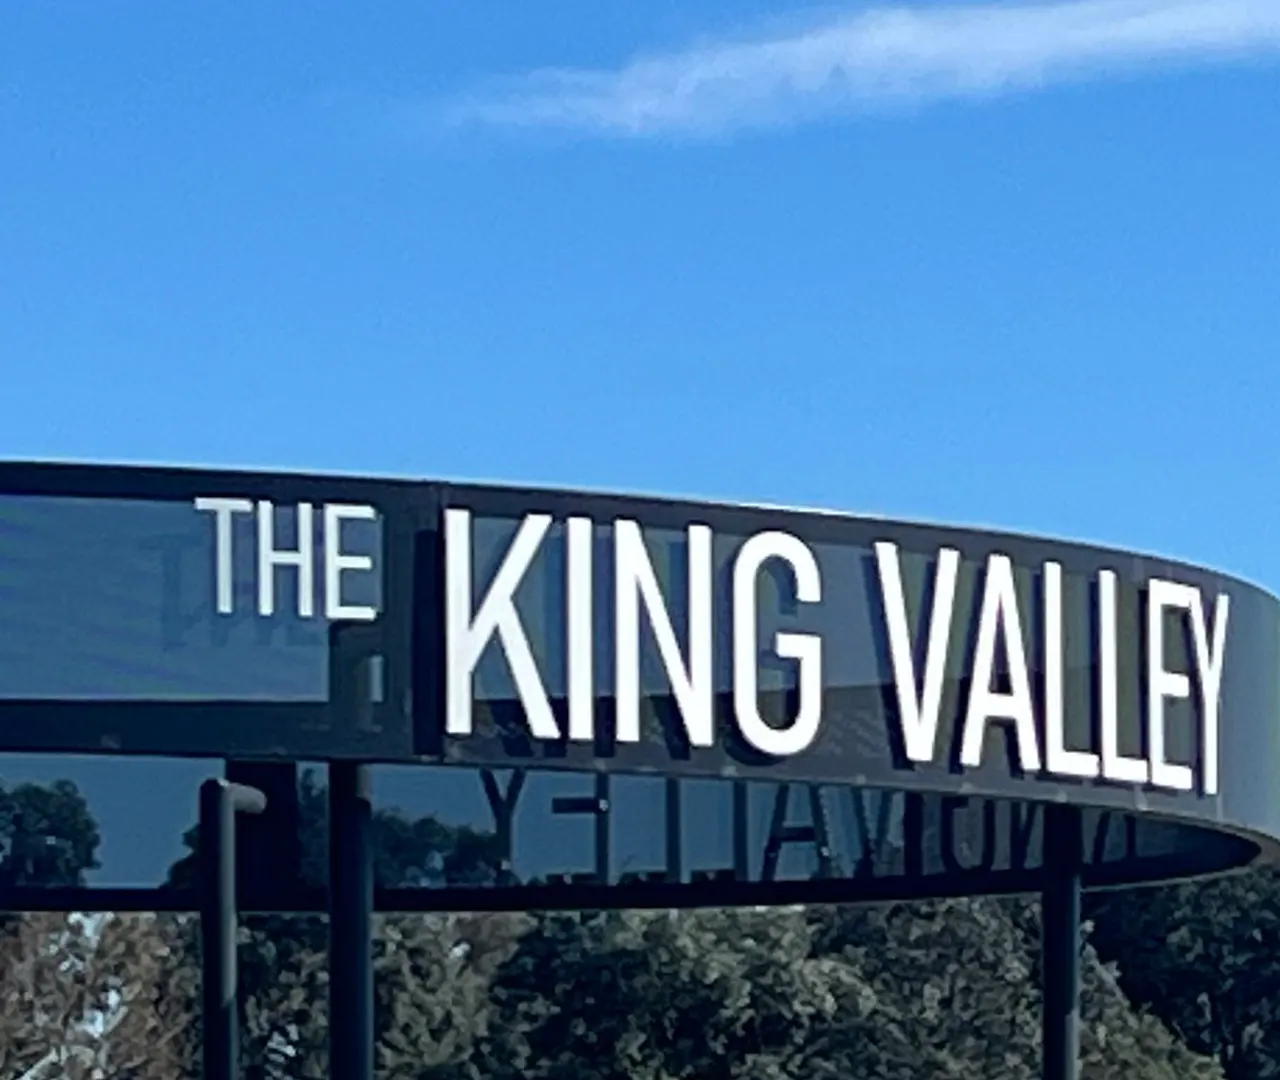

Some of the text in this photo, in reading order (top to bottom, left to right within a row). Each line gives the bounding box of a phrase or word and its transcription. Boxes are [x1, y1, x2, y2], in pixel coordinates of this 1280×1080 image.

[194, 497, 1230, 796] THE KING VALLEY
